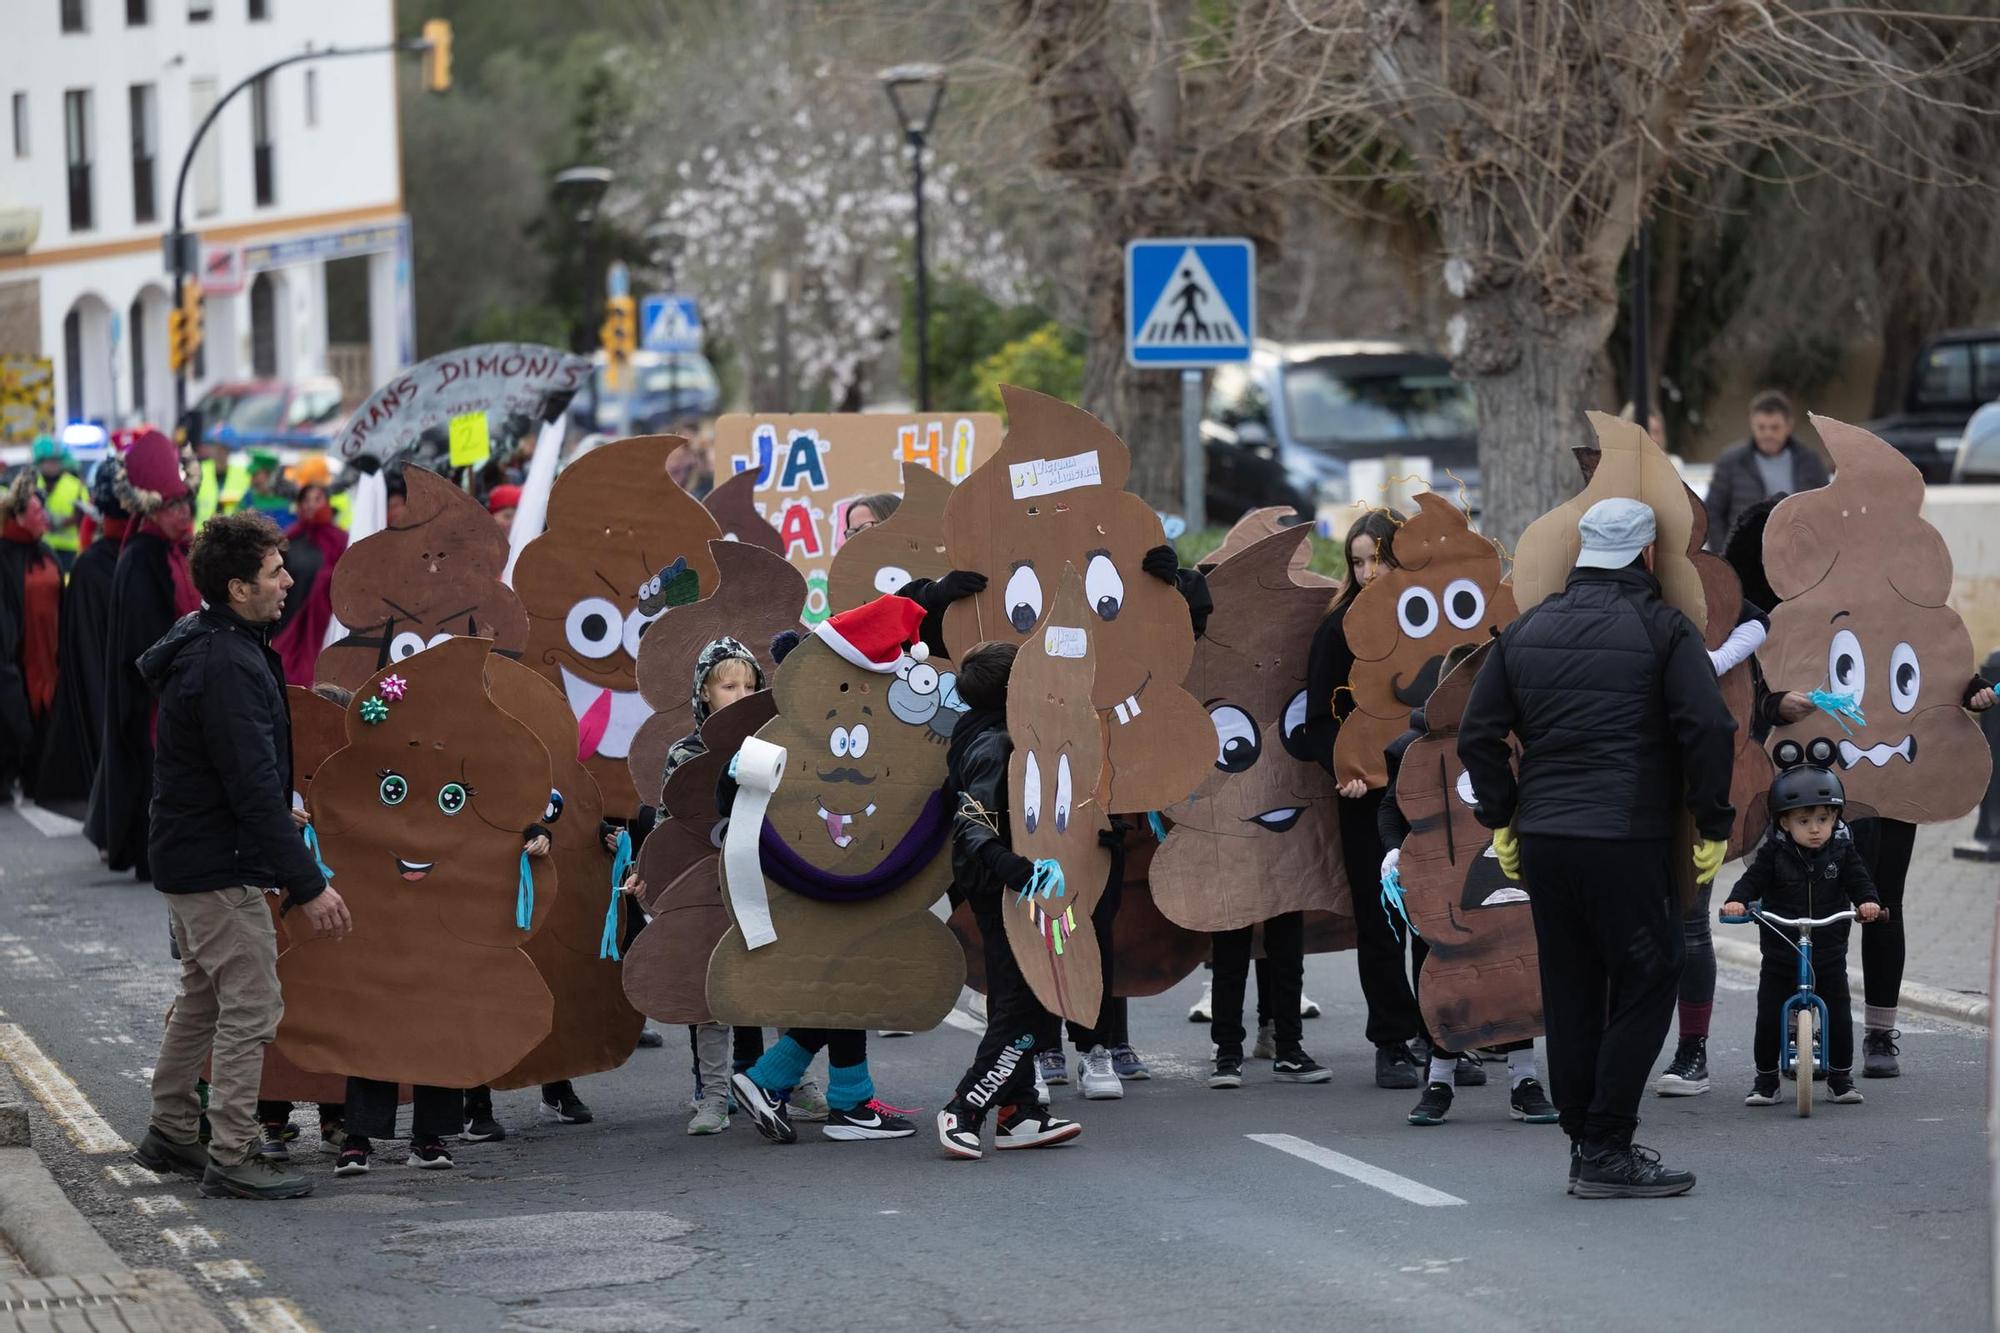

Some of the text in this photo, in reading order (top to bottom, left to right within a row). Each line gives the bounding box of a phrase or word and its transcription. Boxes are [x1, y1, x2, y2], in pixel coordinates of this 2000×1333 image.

[341, 377, 419, 458] GRANS
[435, 352, 593, 394] DIMONIS
[458, 425, 482, 452] 2
[732, 423, 829, 491] JA
